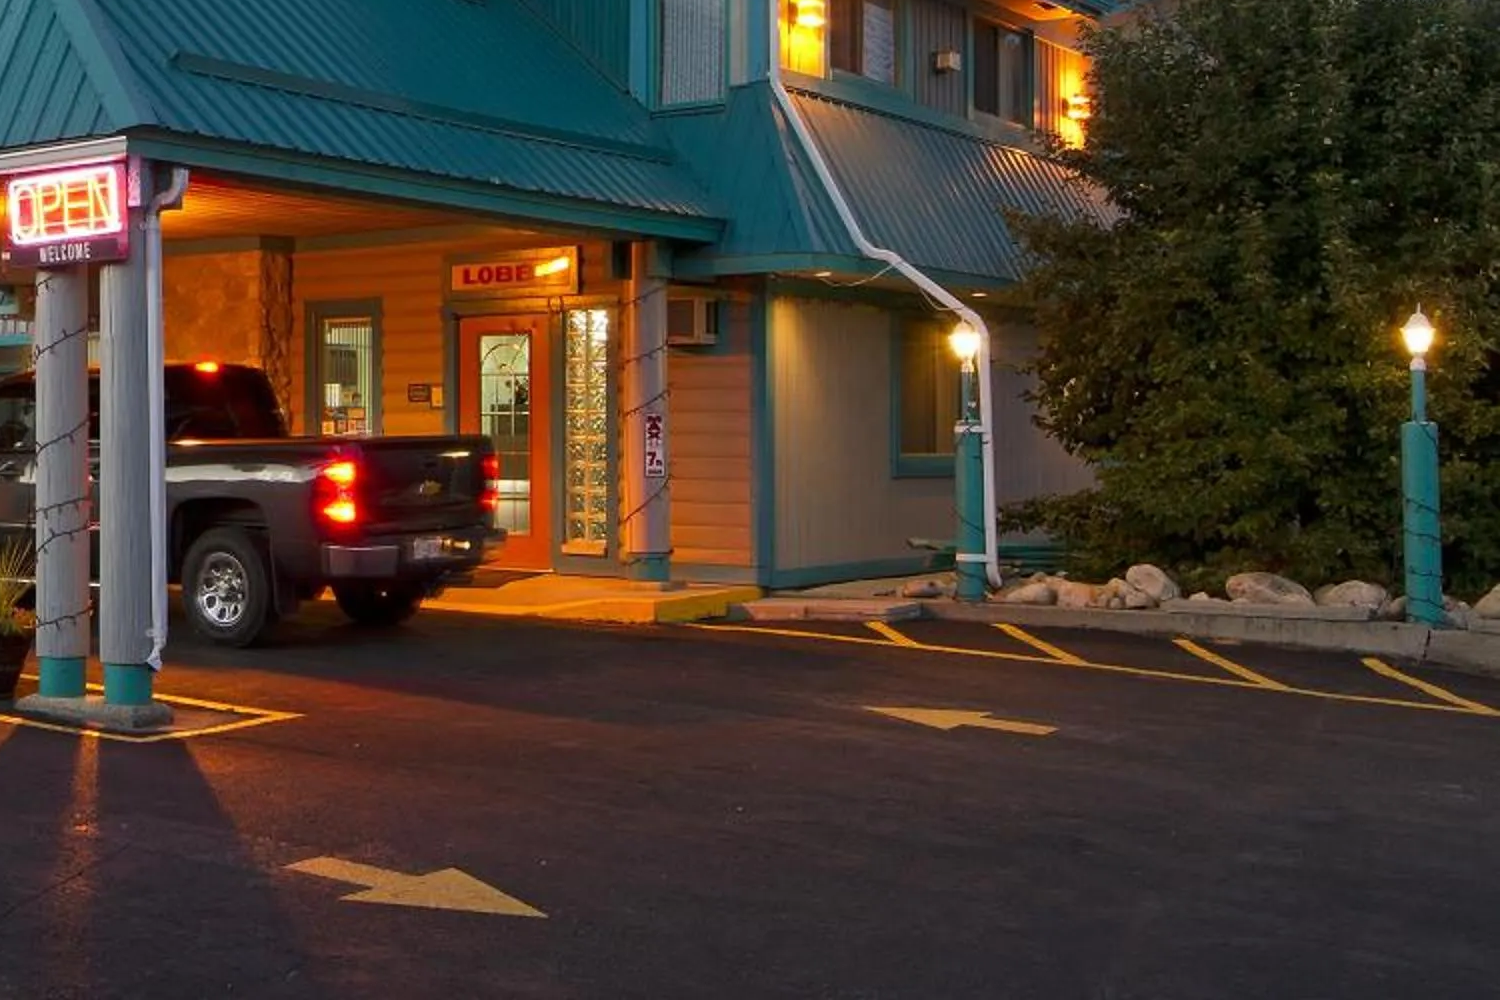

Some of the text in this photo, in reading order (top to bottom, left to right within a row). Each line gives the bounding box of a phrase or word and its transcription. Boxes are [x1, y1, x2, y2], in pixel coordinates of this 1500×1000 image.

[16, 172, 113, 238] OPEN
[39, 242, 92, 263] WELCOME
[463, 262, 554, 285] LOBB
